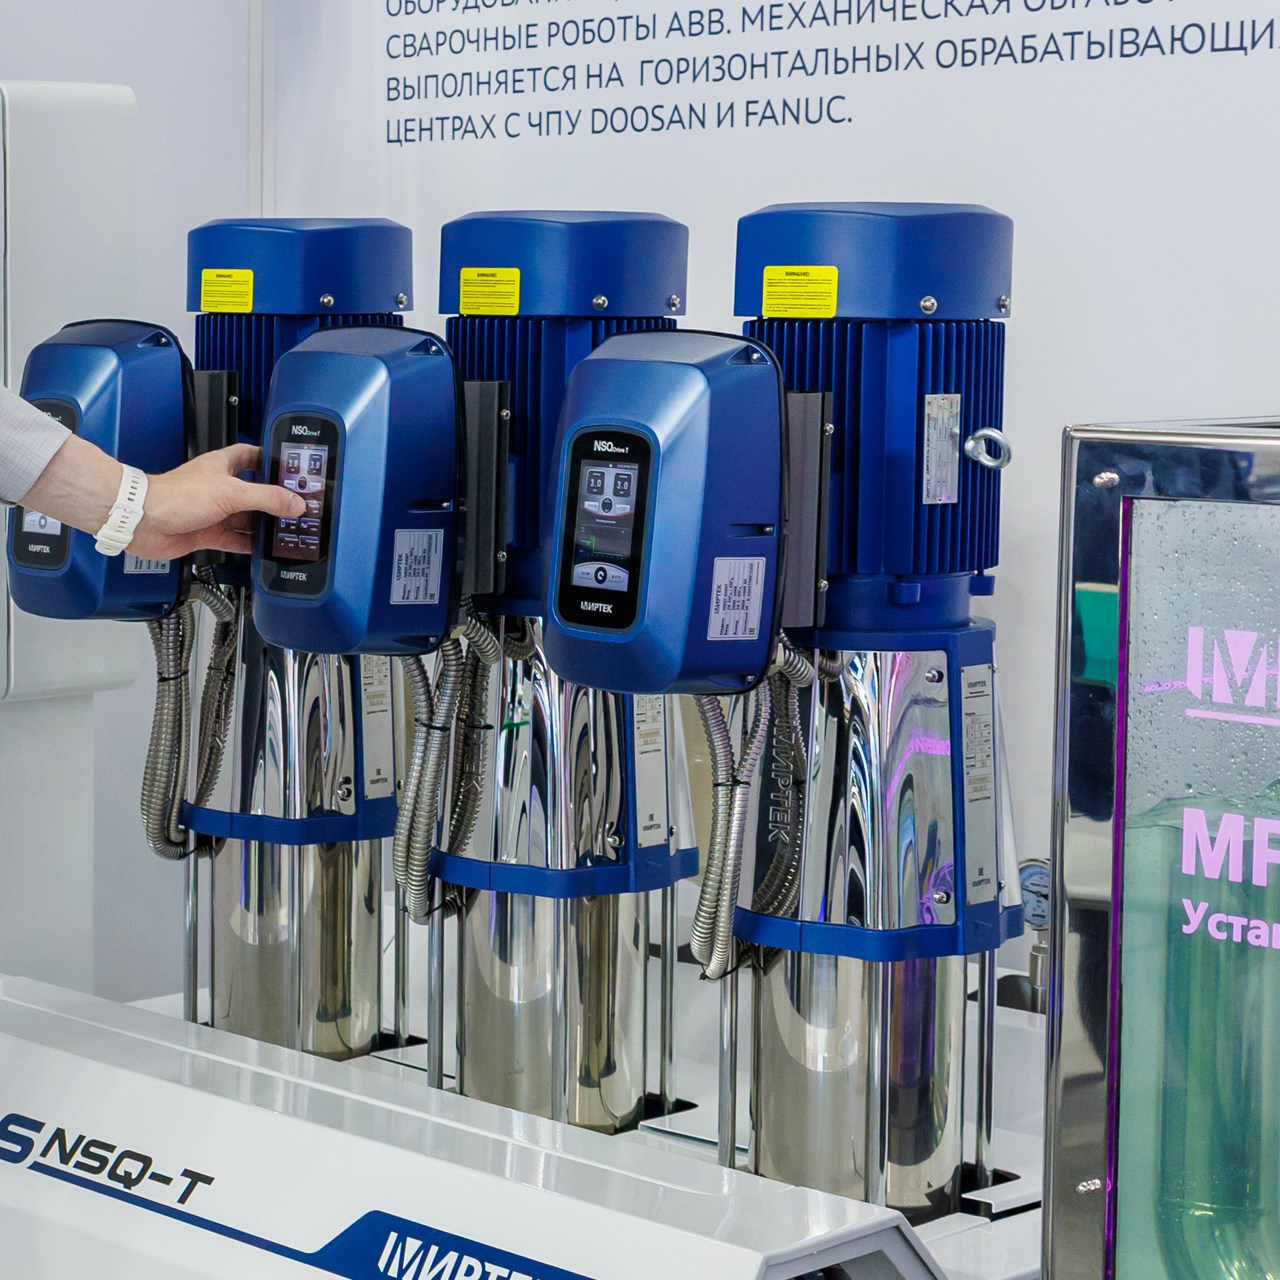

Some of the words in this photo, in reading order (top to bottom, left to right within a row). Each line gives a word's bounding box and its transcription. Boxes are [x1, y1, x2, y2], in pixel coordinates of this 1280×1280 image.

[386, 23, 538, 59] СВАРОЧНЫЕ
[548, 14, 656, 47] РОБОТЫ
[666, 8, 731, 38] ABB.
[387, 65, 576, 101] ВЫПОЛНЯЕТСЯ
[587, 62, 624, 89] НА
[640, 42, 924, 86] ГОРИЗОНТАЛЬНЫХ
[936, 19, 1280, 68] ОБРАБАТЫВАЮЩИ
[387, 114, 496, 147] ЦЕНТРАХ
[505, 112, 520, 138] С
[528, 109, 581, 136] ЧПУ
[592, 103, 705, 134] DOOSAN
[717, 102, 734, 128] И
[746, 95, 852, 127] FANUC.
[589, 478, 602, 488] 3.0
[616, 481, 629, 490] 3.0
[580, 600, 613, 614] МИРТЕК
[767, 718, 796, 843] МИРТЕК
